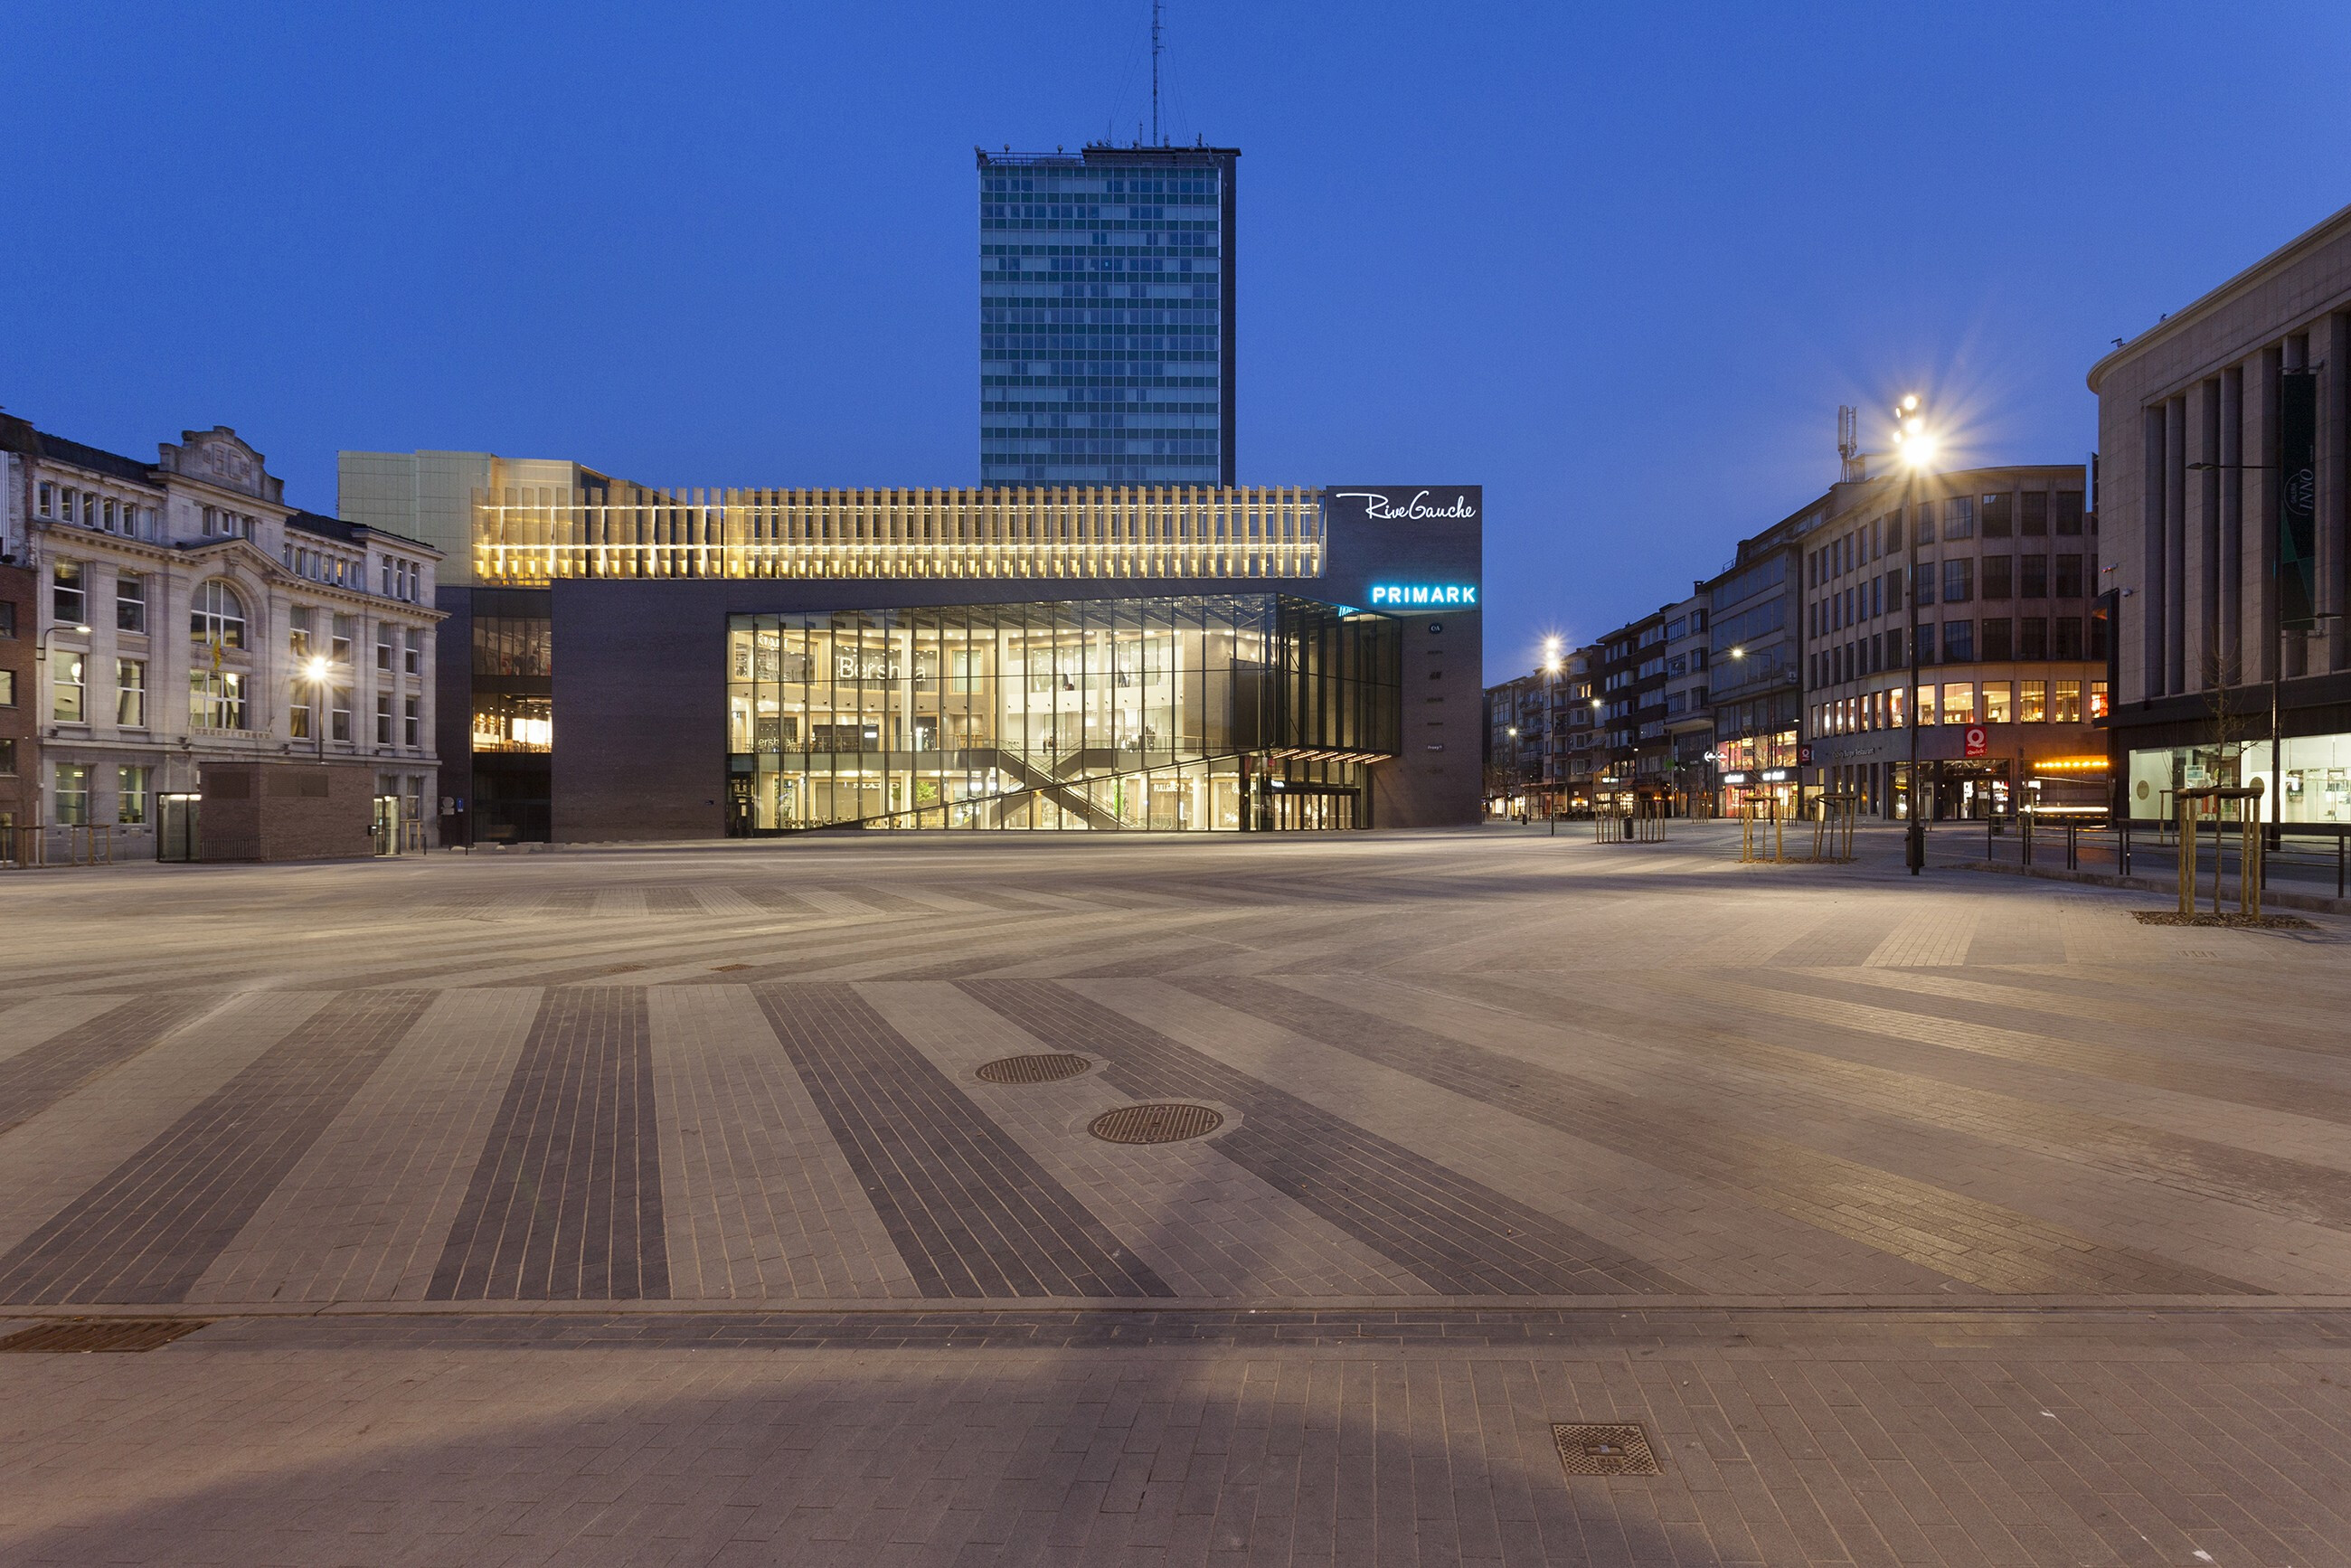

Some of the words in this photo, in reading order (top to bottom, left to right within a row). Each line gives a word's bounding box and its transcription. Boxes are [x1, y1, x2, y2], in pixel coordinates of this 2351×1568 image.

[2299, 468, 2314, 510] INNO
[1373, 586, 1476, 604] PRIMARK
[839, 656, 926, 682] Bersha
